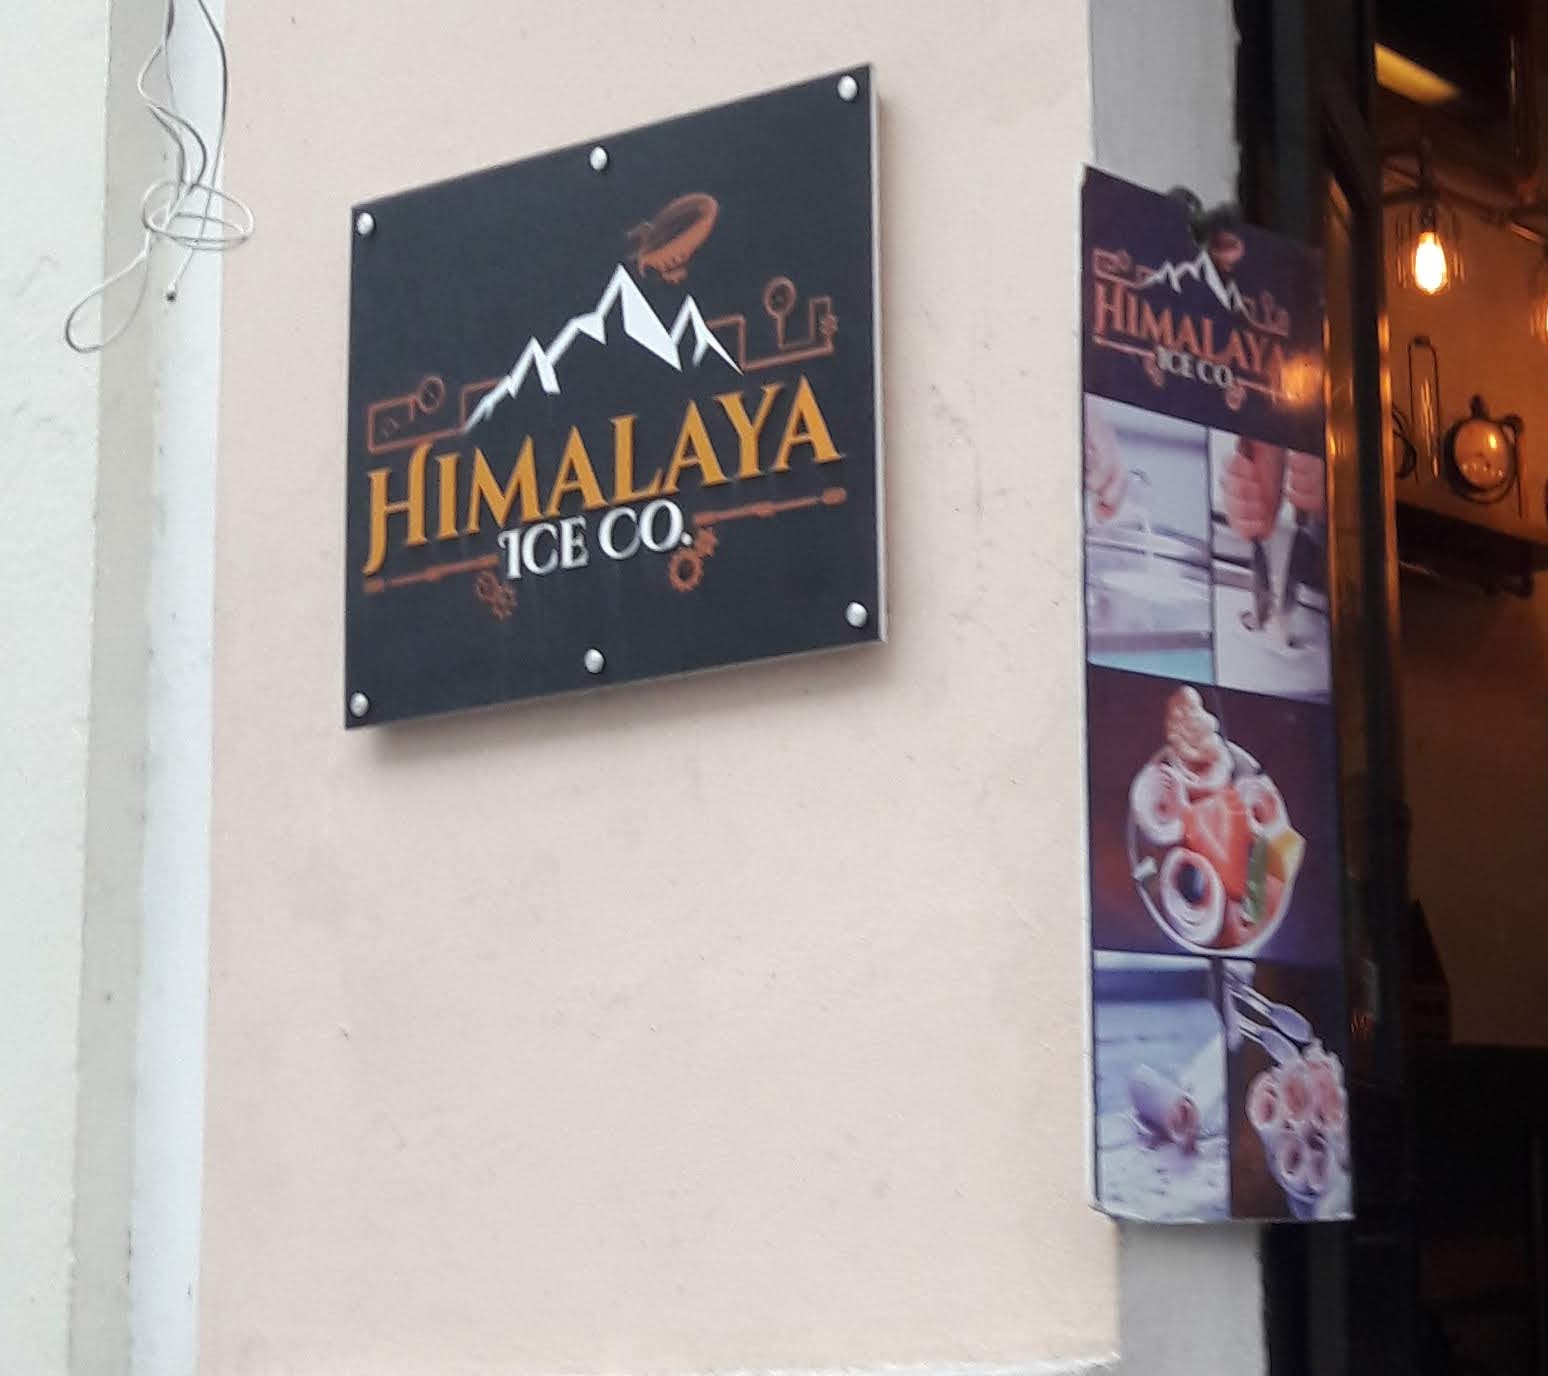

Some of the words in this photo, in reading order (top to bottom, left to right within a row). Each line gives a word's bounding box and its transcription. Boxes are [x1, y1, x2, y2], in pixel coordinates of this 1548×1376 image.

[362, 376, 847, 575] HIMALAYA
[498, 514, 589, 579] ICE
[599, 497, 693, 560] CO.
